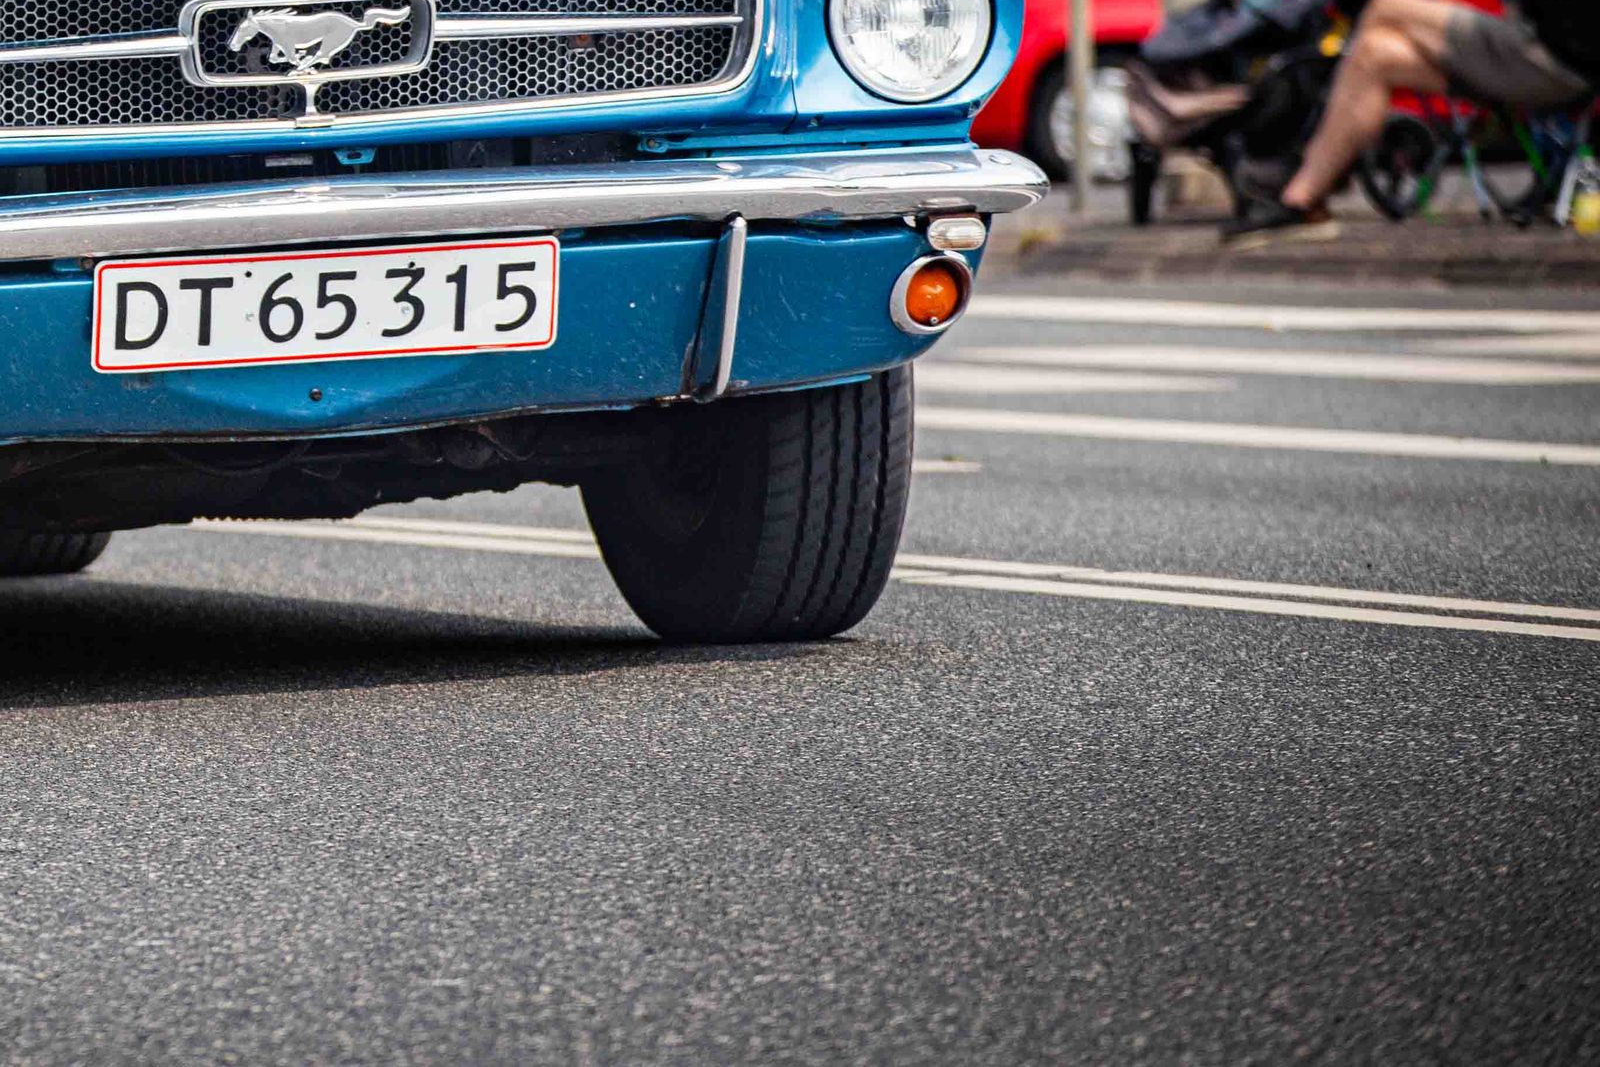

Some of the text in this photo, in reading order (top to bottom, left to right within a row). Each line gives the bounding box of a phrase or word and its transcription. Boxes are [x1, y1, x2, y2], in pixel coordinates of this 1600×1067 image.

[115, 261, 537, 350] DT 65 315
